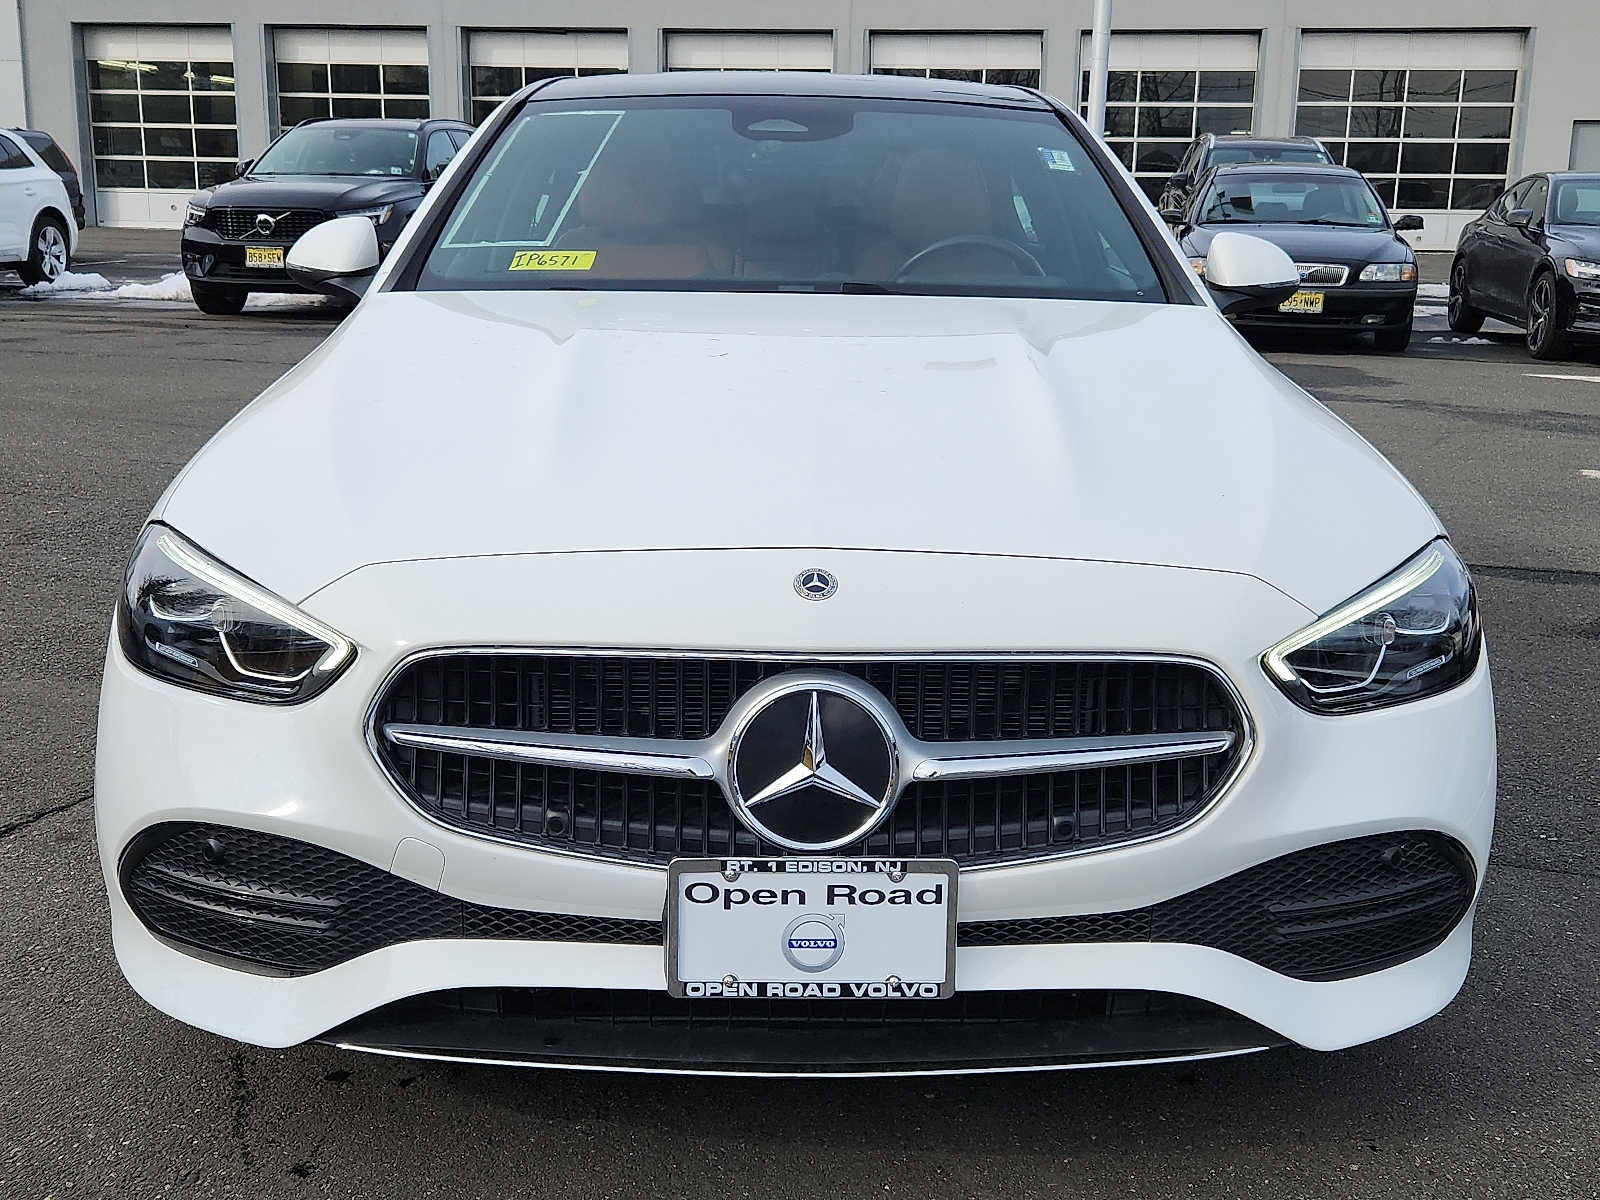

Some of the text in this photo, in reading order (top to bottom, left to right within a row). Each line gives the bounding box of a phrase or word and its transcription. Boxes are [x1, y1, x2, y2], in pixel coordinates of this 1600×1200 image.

[511, 253, 578, 269] IP6571
[726, 860, 902, 873] RT. 1 EDISON, NJ
[684, 882, 943, 910] Open Road
[789, 940, 835, 948] VOLVO
[685, 982, 938, 997] OPEN ROAD VOLVO
